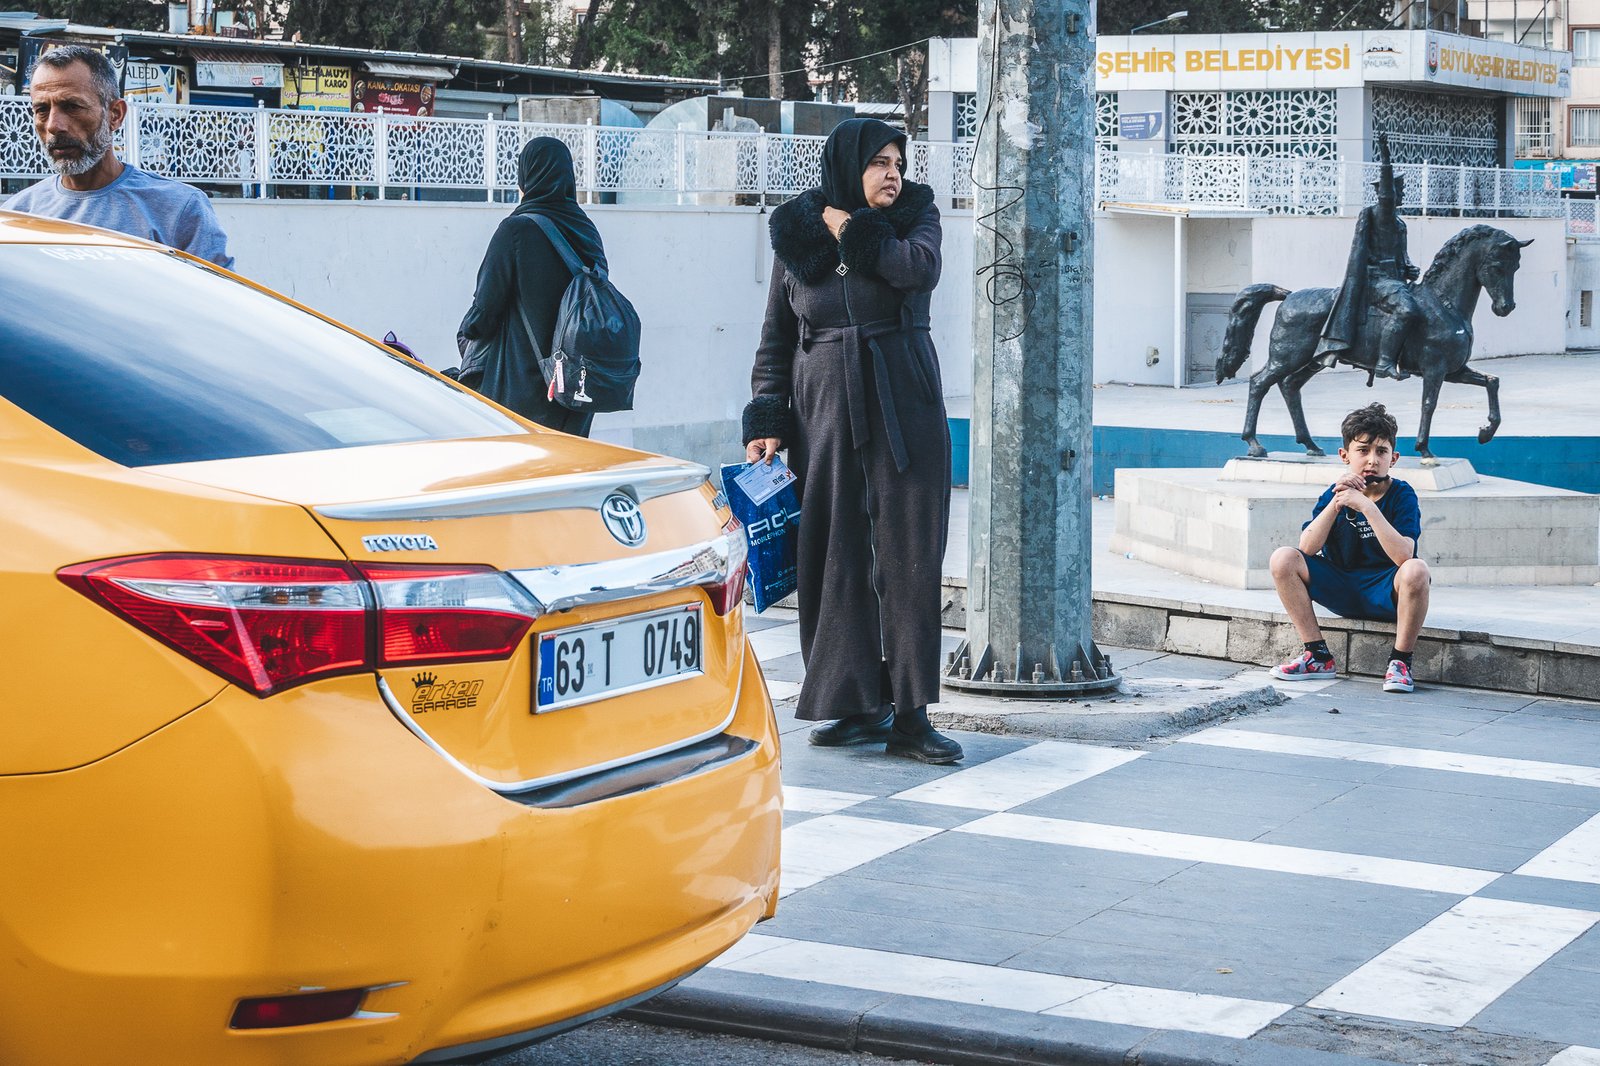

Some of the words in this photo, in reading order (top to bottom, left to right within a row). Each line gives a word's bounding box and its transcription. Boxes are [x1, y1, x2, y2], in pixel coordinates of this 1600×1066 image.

[1097, 46, 1176, 79] ŞEHİR
[1185, 43, 1350, 72] BELEDİYESİ
[1440, 45, 1504, 81] BÜYÜKŞEHİR
[1505, 59, 1557, 84] BELEDİYESİ
[324, 79, 348, 89] KARGO
[363, 535, 438, 552] TOYOTA
[556, 637, 585, 696] 63
[602, 631, 615, 686] T
[644, 615, 696, 677] 0749
[412, 679, 484, 703] erten
[542, 677, 553, 693] TR
[412, 697, 477, 714] GARAGE
